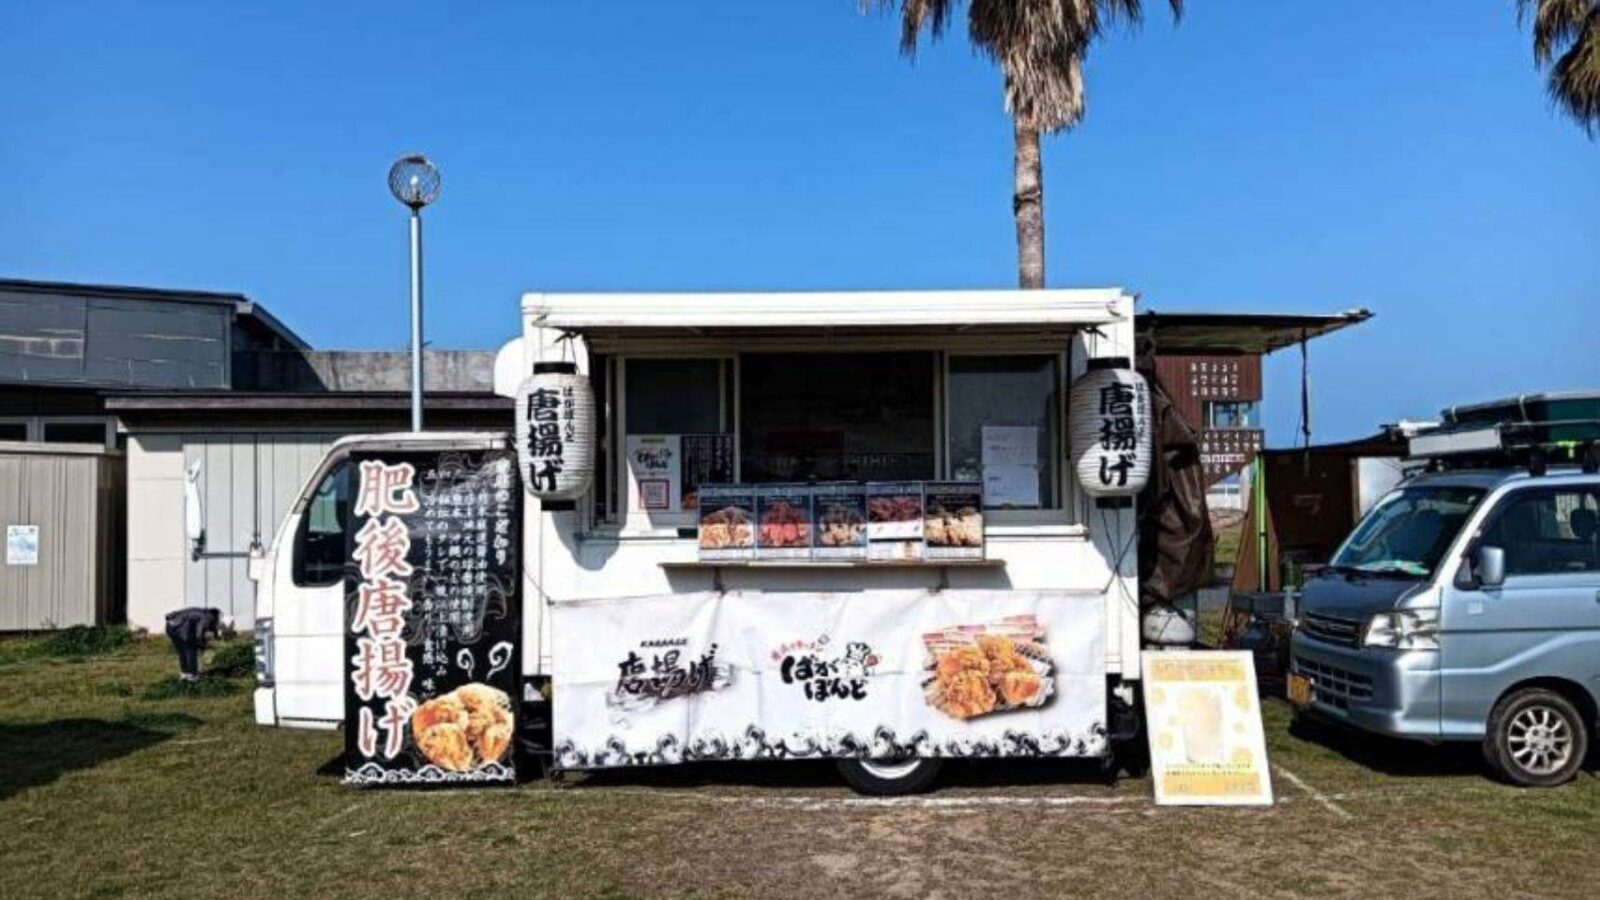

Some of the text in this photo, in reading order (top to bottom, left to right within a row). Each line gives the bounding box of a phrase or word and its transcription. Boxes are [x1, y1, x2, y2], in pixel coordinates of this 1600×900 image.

[527, 387, 563, 491] 唐揚げ
[1099, 382, 1136, 486] 唐揚げ
[353, 459, 418, 760] 肥後唐揚げ
